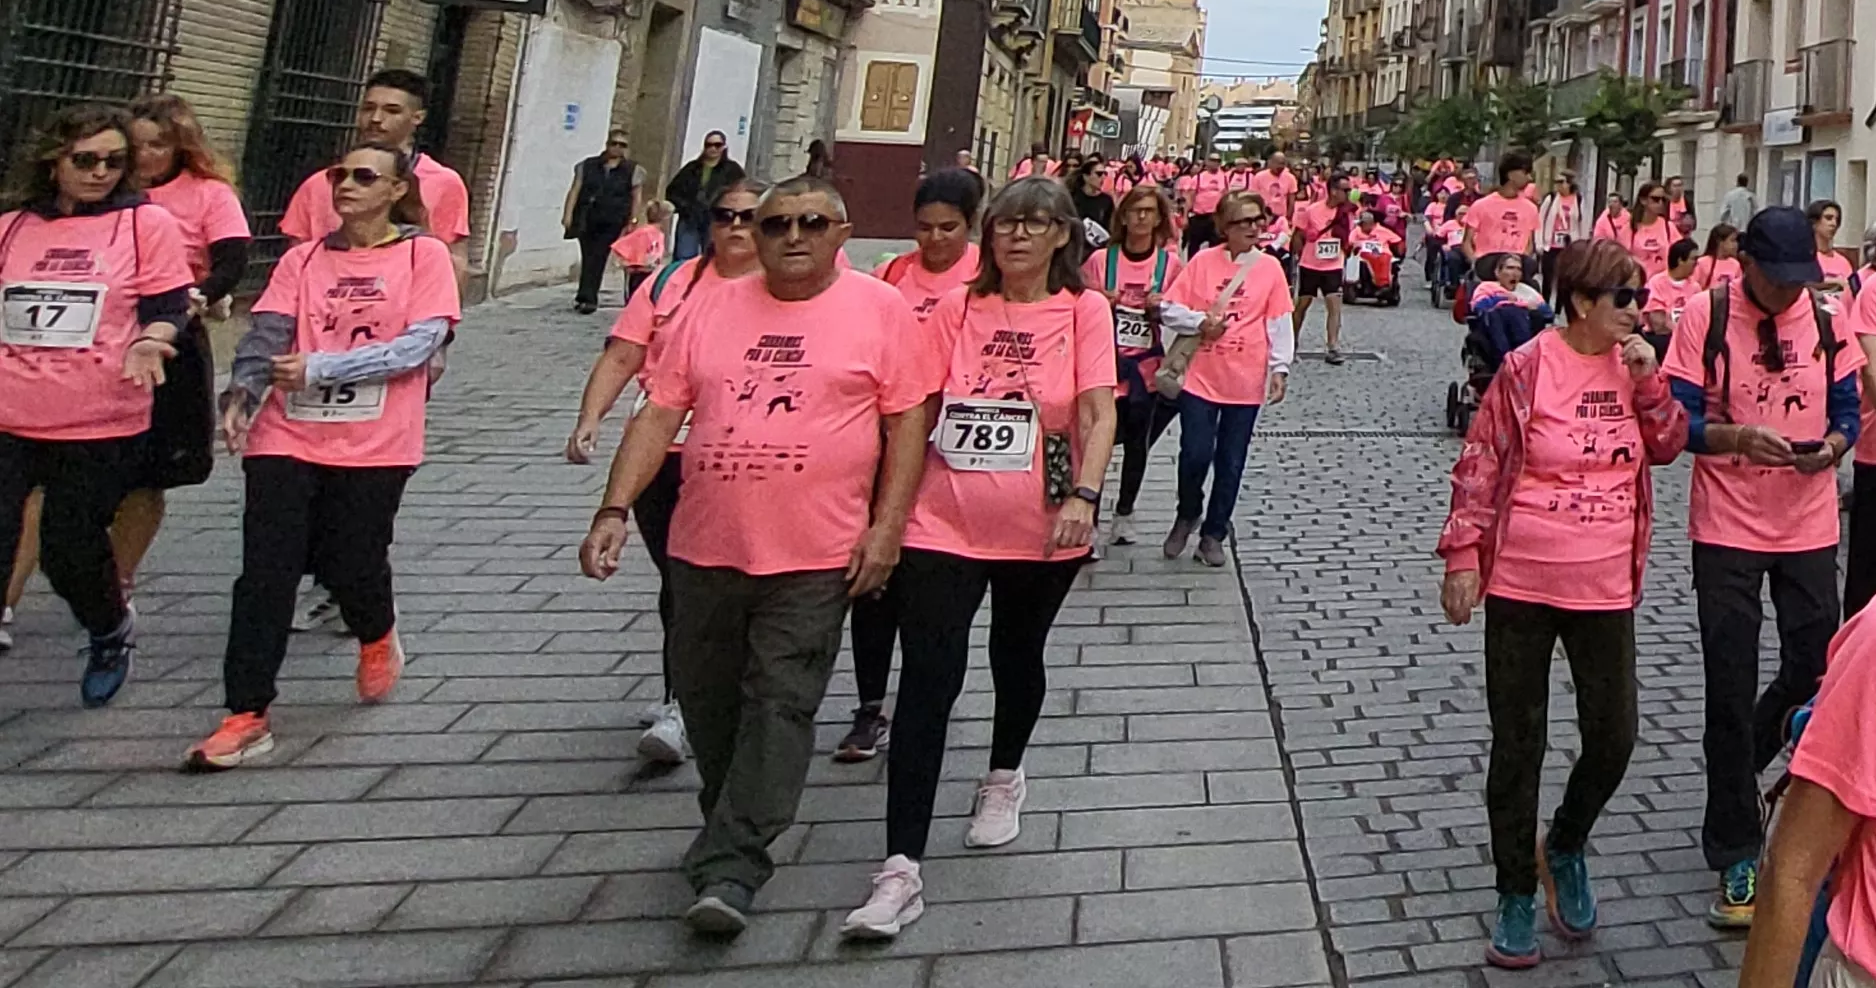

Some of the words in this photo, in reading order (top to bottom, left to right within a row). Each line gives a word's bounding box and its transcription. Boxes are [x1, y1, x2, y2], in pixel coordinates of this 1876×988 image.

[26, 305, 68, 328] 17
[318, 381, 357, 405] 15
[954, 423, 1015, 451] 789
